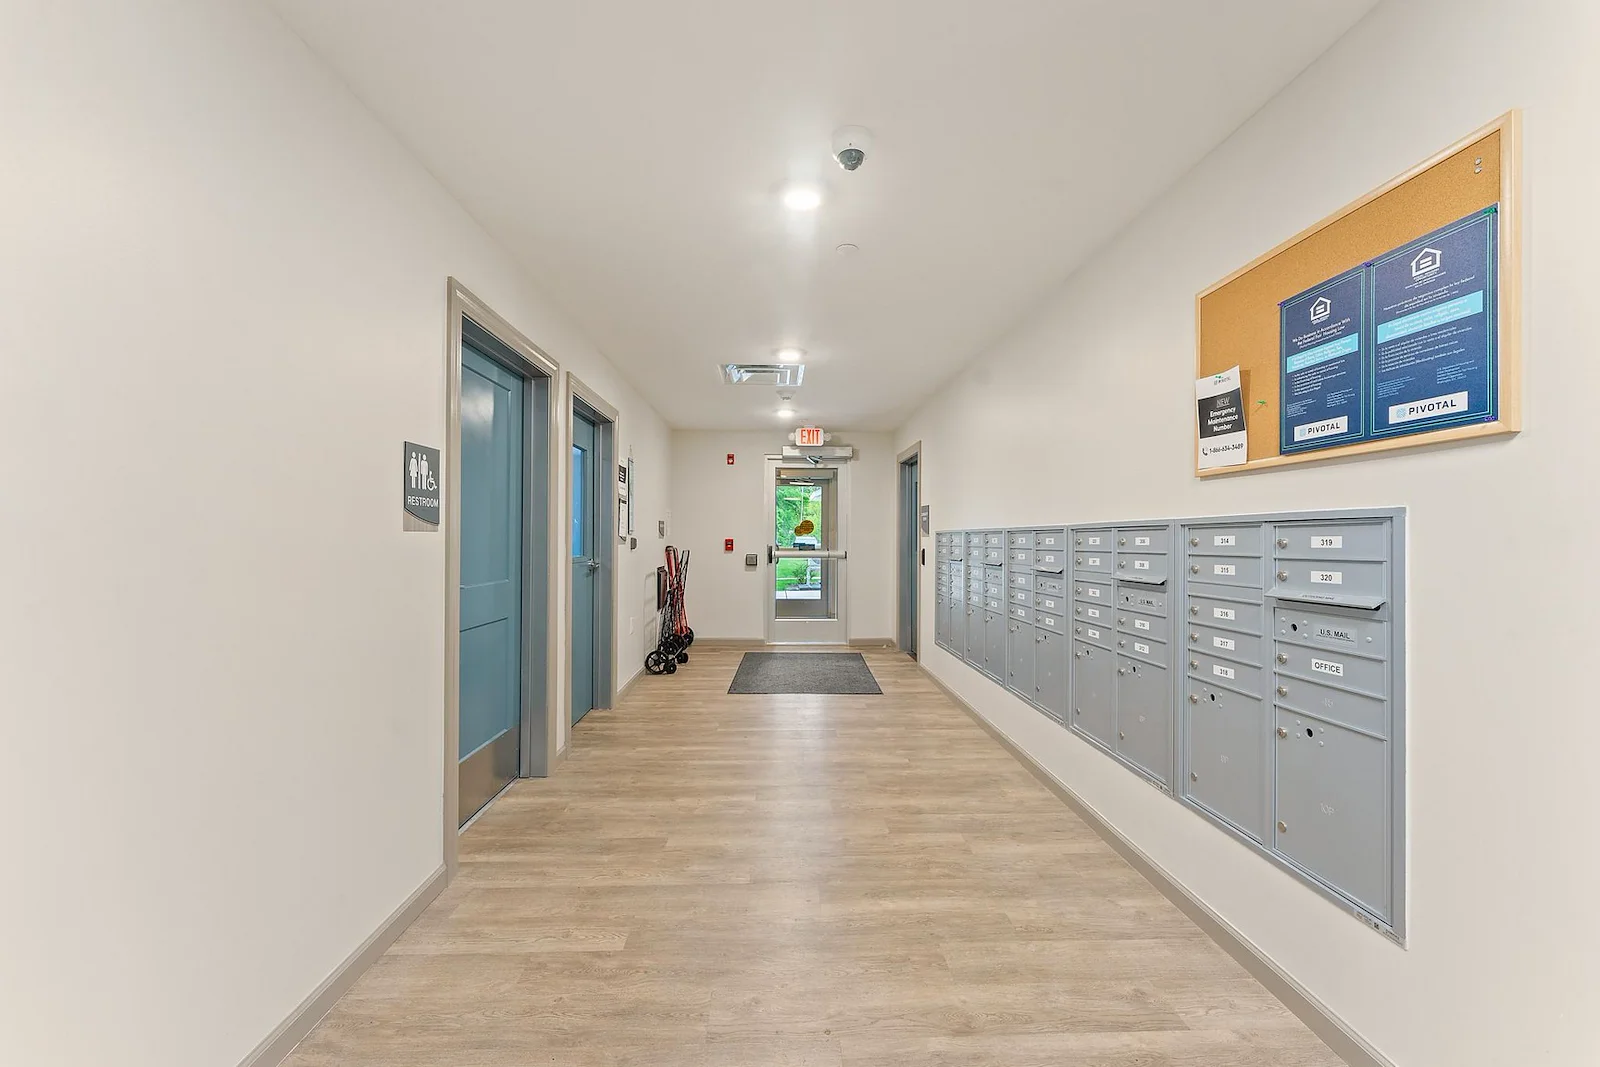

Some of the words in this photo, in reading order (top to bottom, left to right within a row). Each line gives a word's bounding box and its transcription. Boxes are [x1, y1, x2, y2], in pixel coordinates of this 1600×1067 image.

[1210, 407, 1236, 417] Emergency
[1408, 399, 1457, 415] PIVOTAL
[1207, 414, 1238, 425] Maintenance
[1213, 423, 1232, 432] Number
[1307, 422, 1341, 435] PIVOTAL
[801, 429, 821, 444] EXIT
[407, 495, 439, 508] RESTROOM
[1320, 538, 1333, 546] 319
[1320, 574, 1333, 582] 320
[1320, 628, 1332, 637] U.S.
[1333, 630, 1350, 640] MAIL
[1314, 661, 1340, 673] OFFICE
